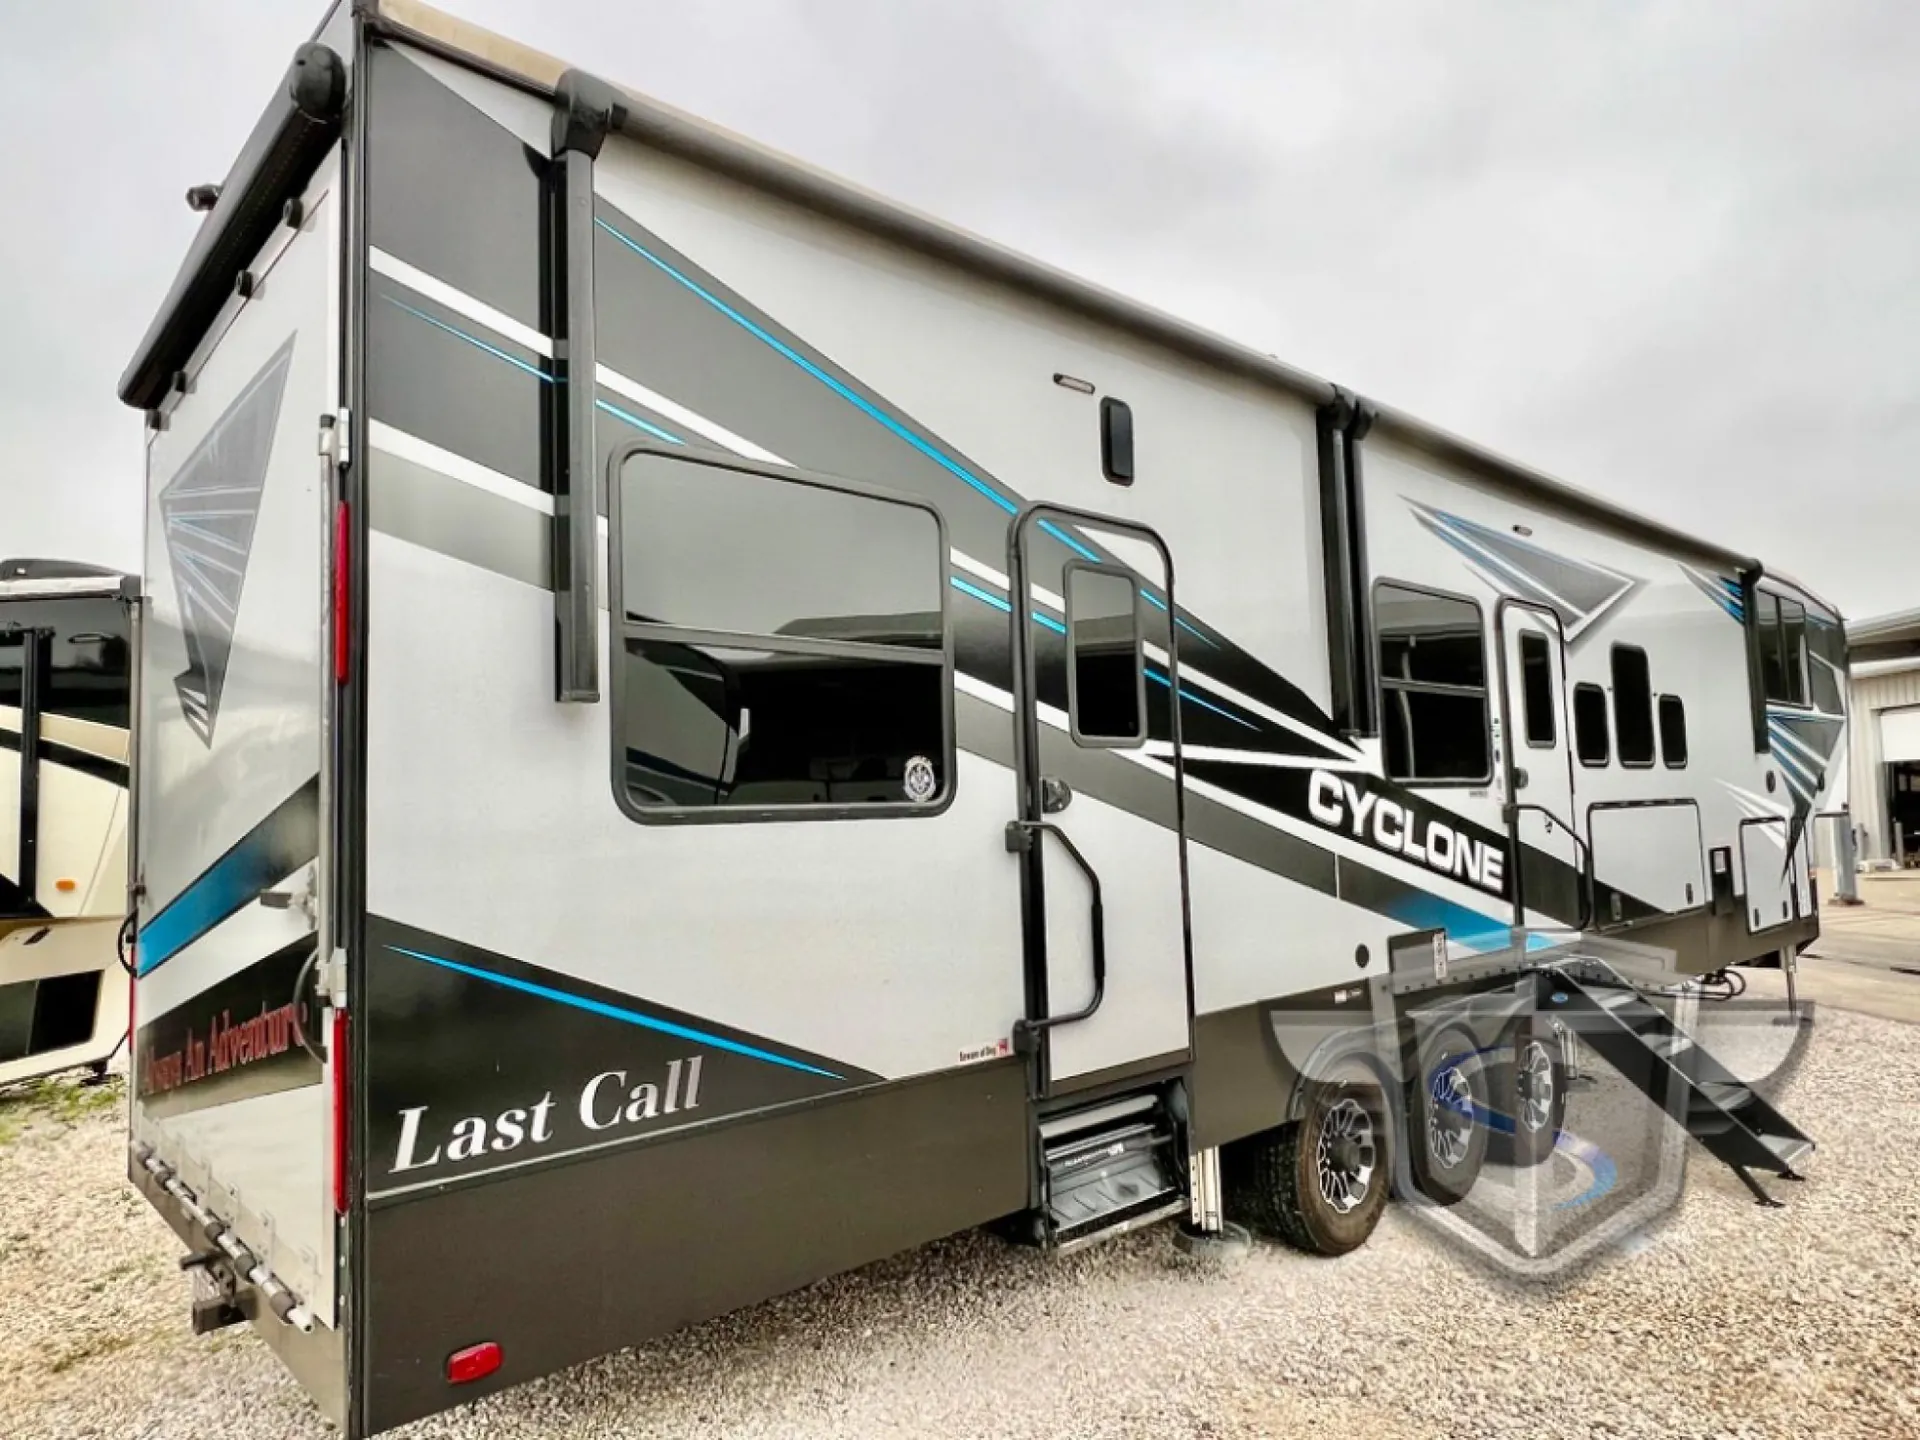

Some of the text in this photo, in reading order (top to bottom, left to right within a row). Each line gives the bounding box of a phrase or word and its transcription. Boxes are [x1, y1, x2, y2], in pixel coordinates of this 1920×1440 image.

[1308, 768, 1505, 893] CYCLONE
[387, 1055, 704, 1175] Last Call
